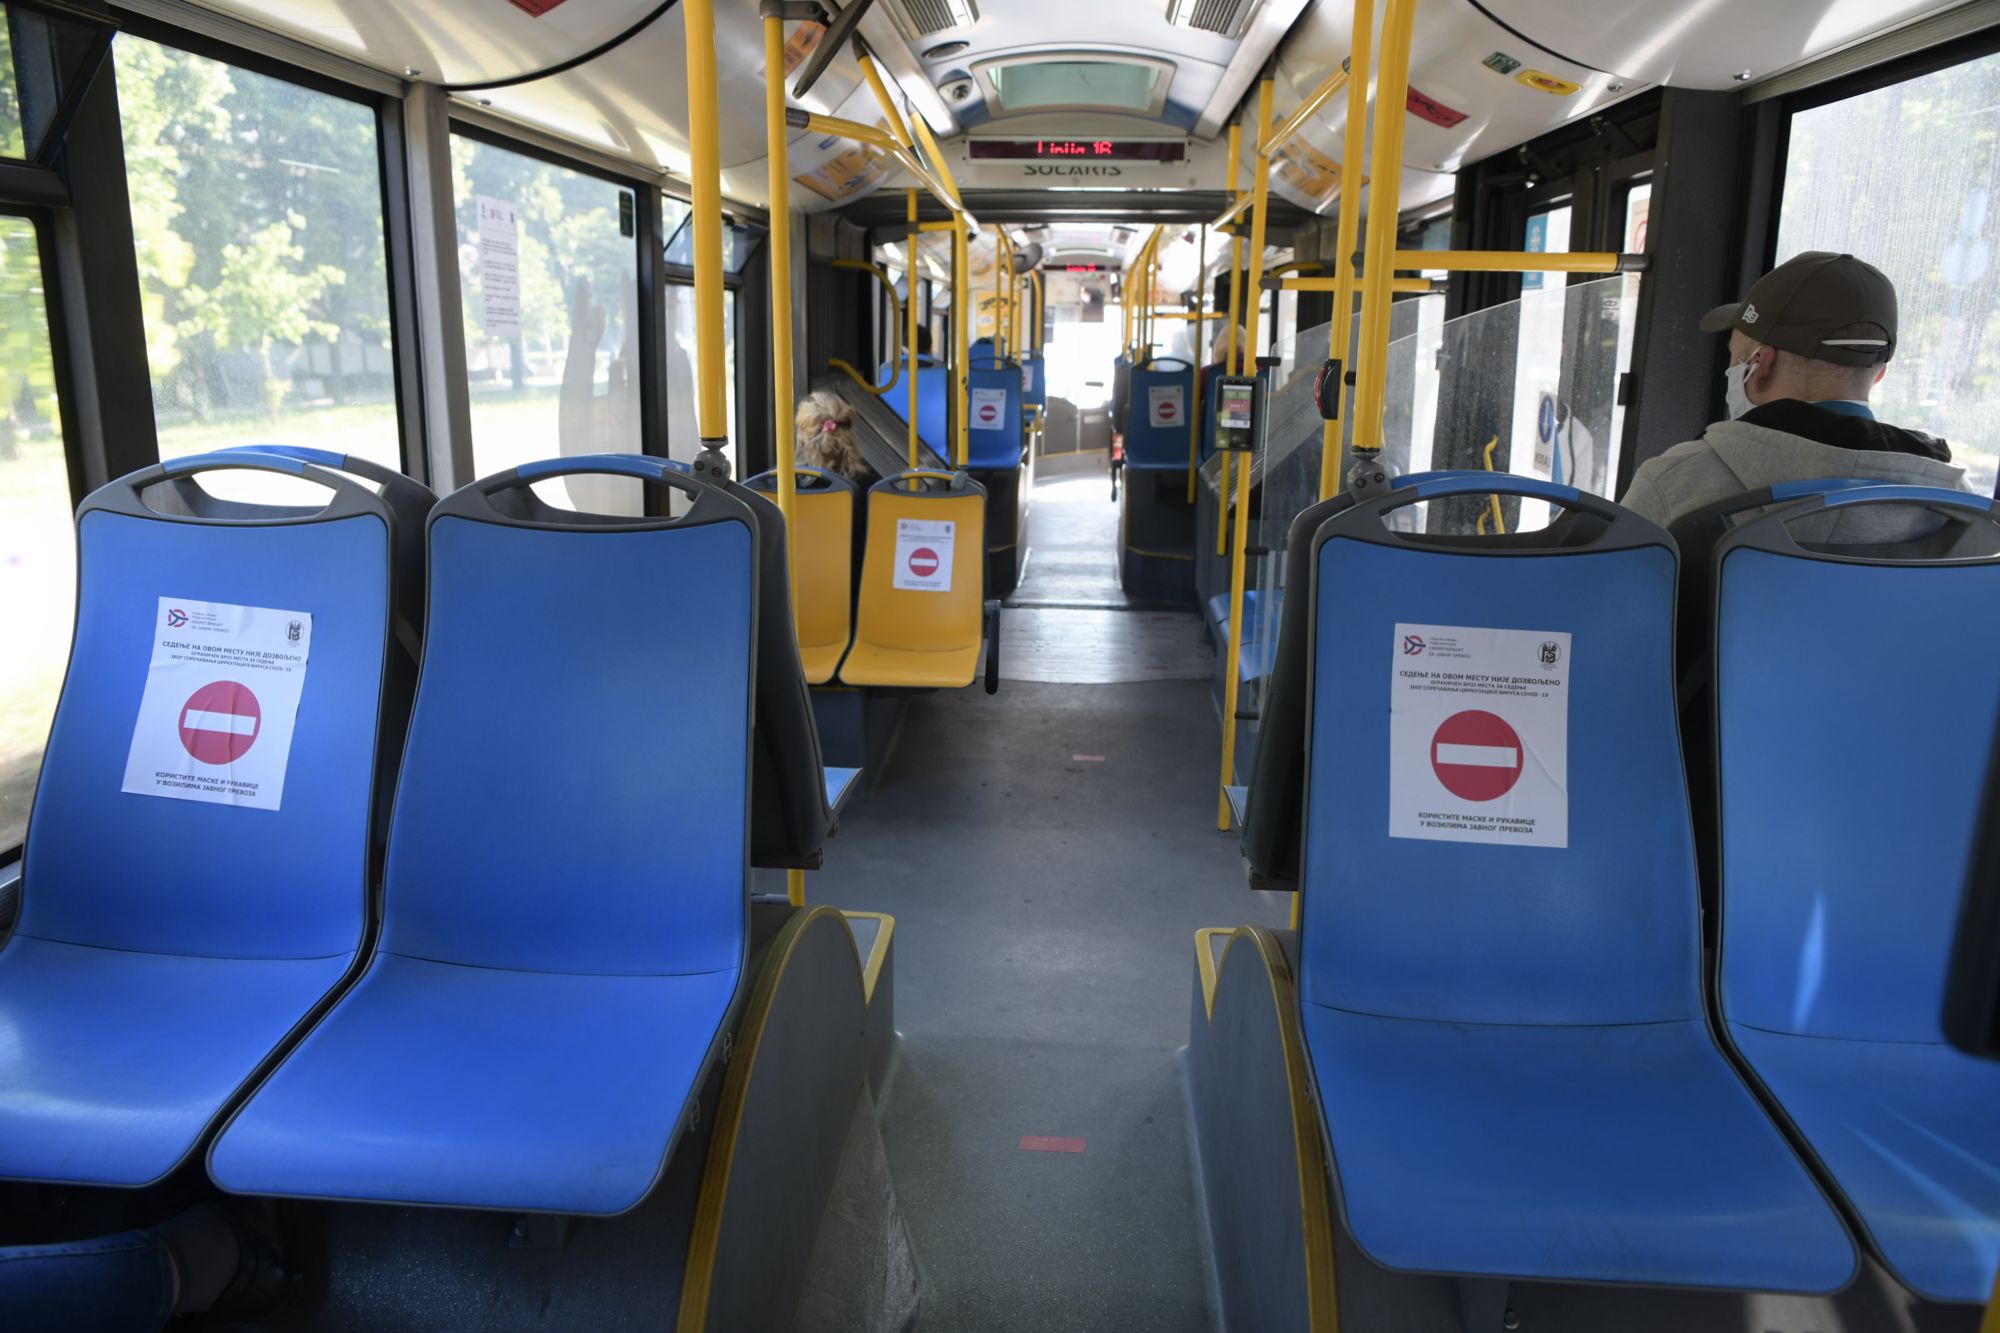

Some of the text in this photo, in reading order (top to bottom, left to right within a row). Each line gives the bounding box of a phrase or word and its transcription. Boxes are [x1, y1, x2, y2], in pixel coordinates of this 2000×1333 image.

[1512, 677, 1560, 686] ДОЗВОЉЕНО
[155, 772, 196, 782] КОРИСТИТЕ
[162, 780, 200, 790] ВОЗИЛИМА
[1418, 812, 1460, 820] КОРИСТИТЕ
[1496, 817, 1535, 826] РУКАВИЦЕ
[1426, 821, 1467, 830] ВОЗИЛИМА
